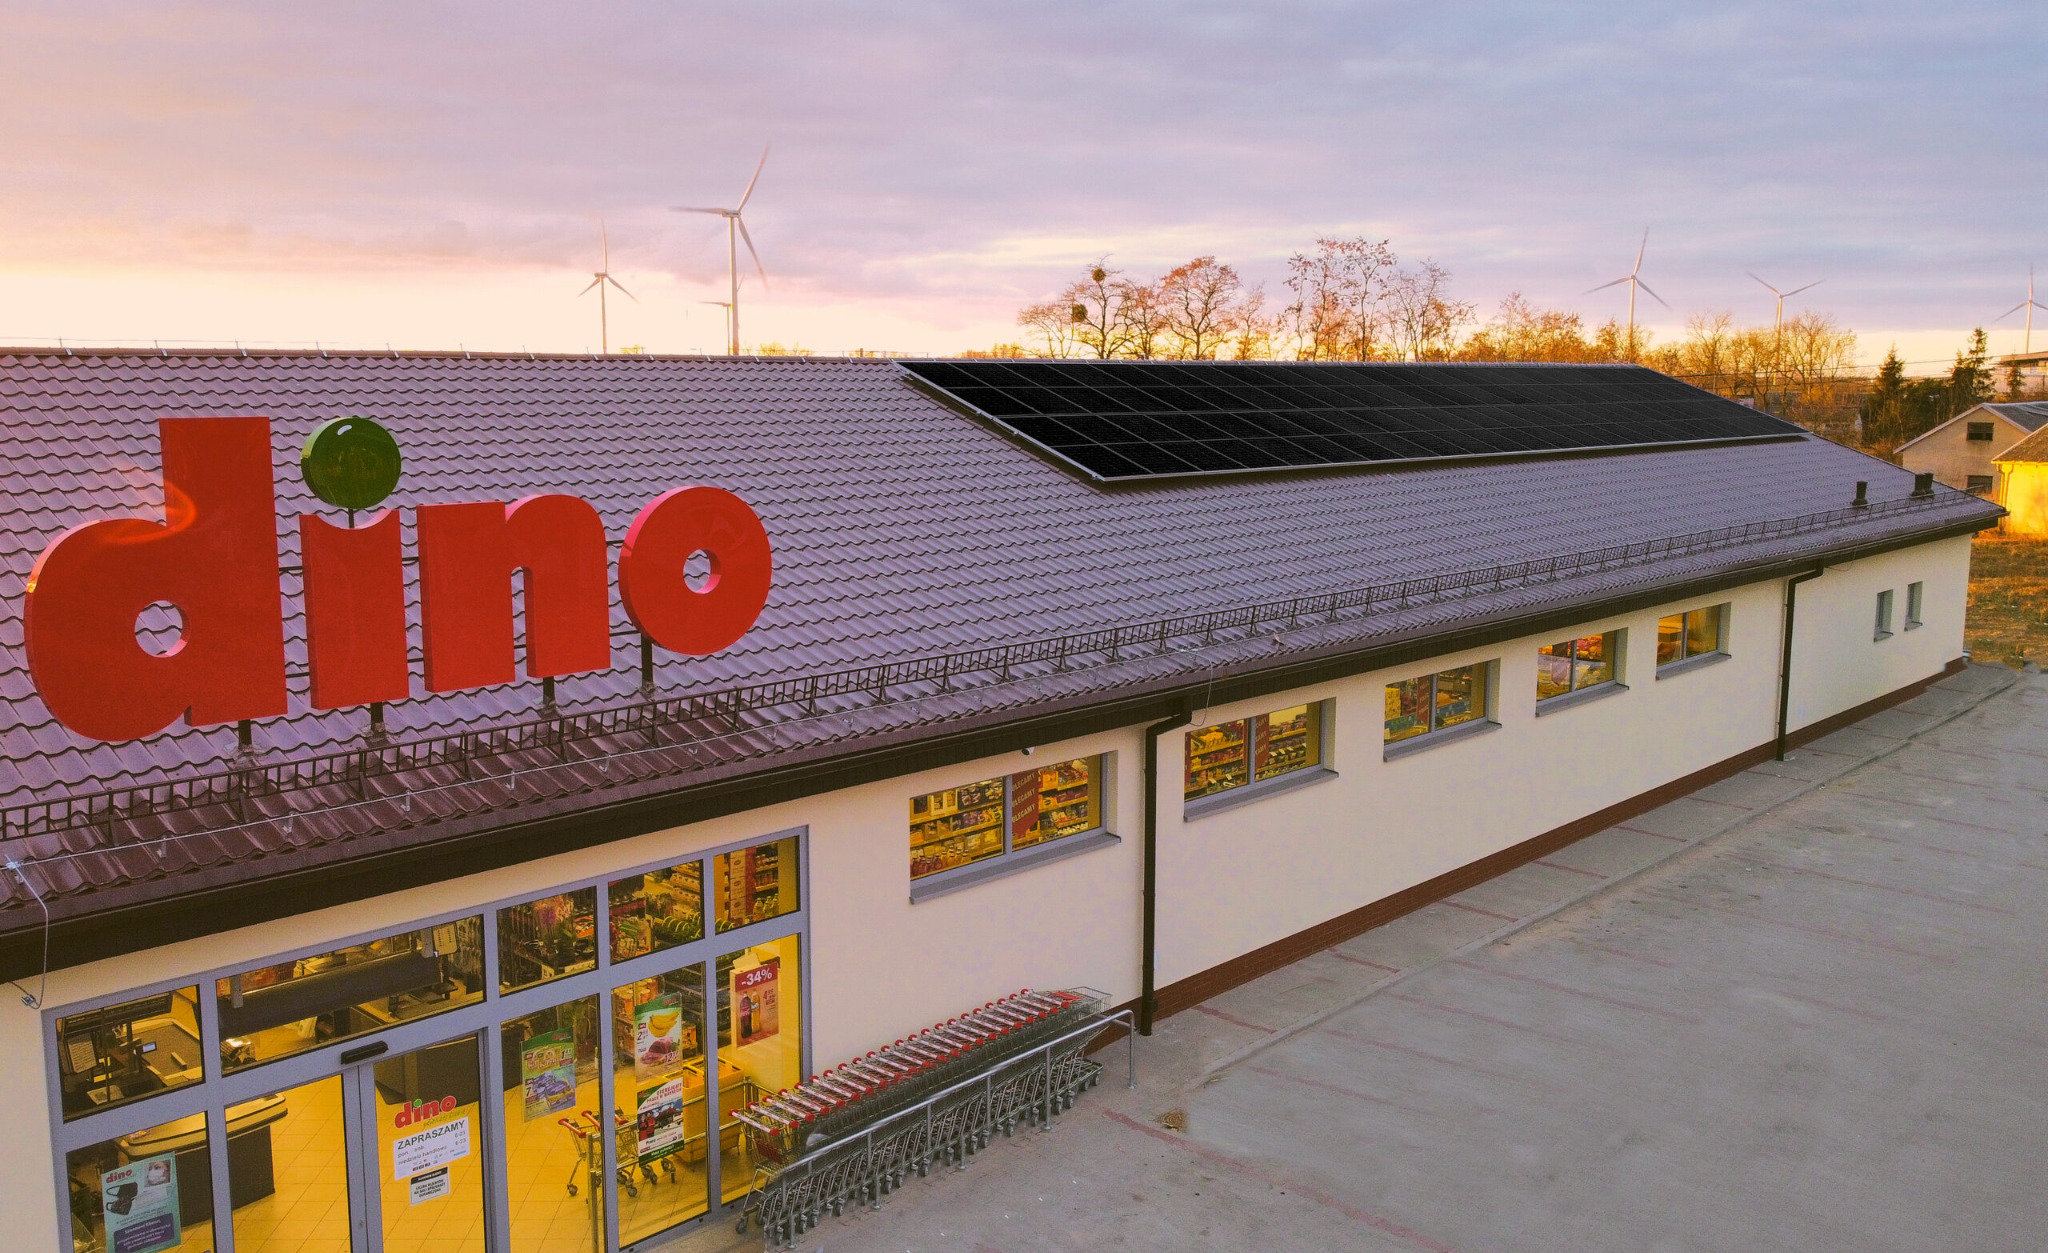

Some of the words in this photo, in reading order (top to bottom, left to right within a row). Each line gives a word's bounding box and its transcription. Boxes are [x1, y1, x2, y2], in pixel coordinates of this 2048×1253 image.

[24, 416, 772, 742] dino
[1012, 773, 1035, 791] OLECAMY
[1012, 788, 1036, 807] OLECAMY
[1012, 803, 1036, 823] OLECAMY
[742, 968, 772, 986] -34%
[395, 1095, 456, 1128] dino
[397, 1120, 465, 1150] ZAPRASZAMY
